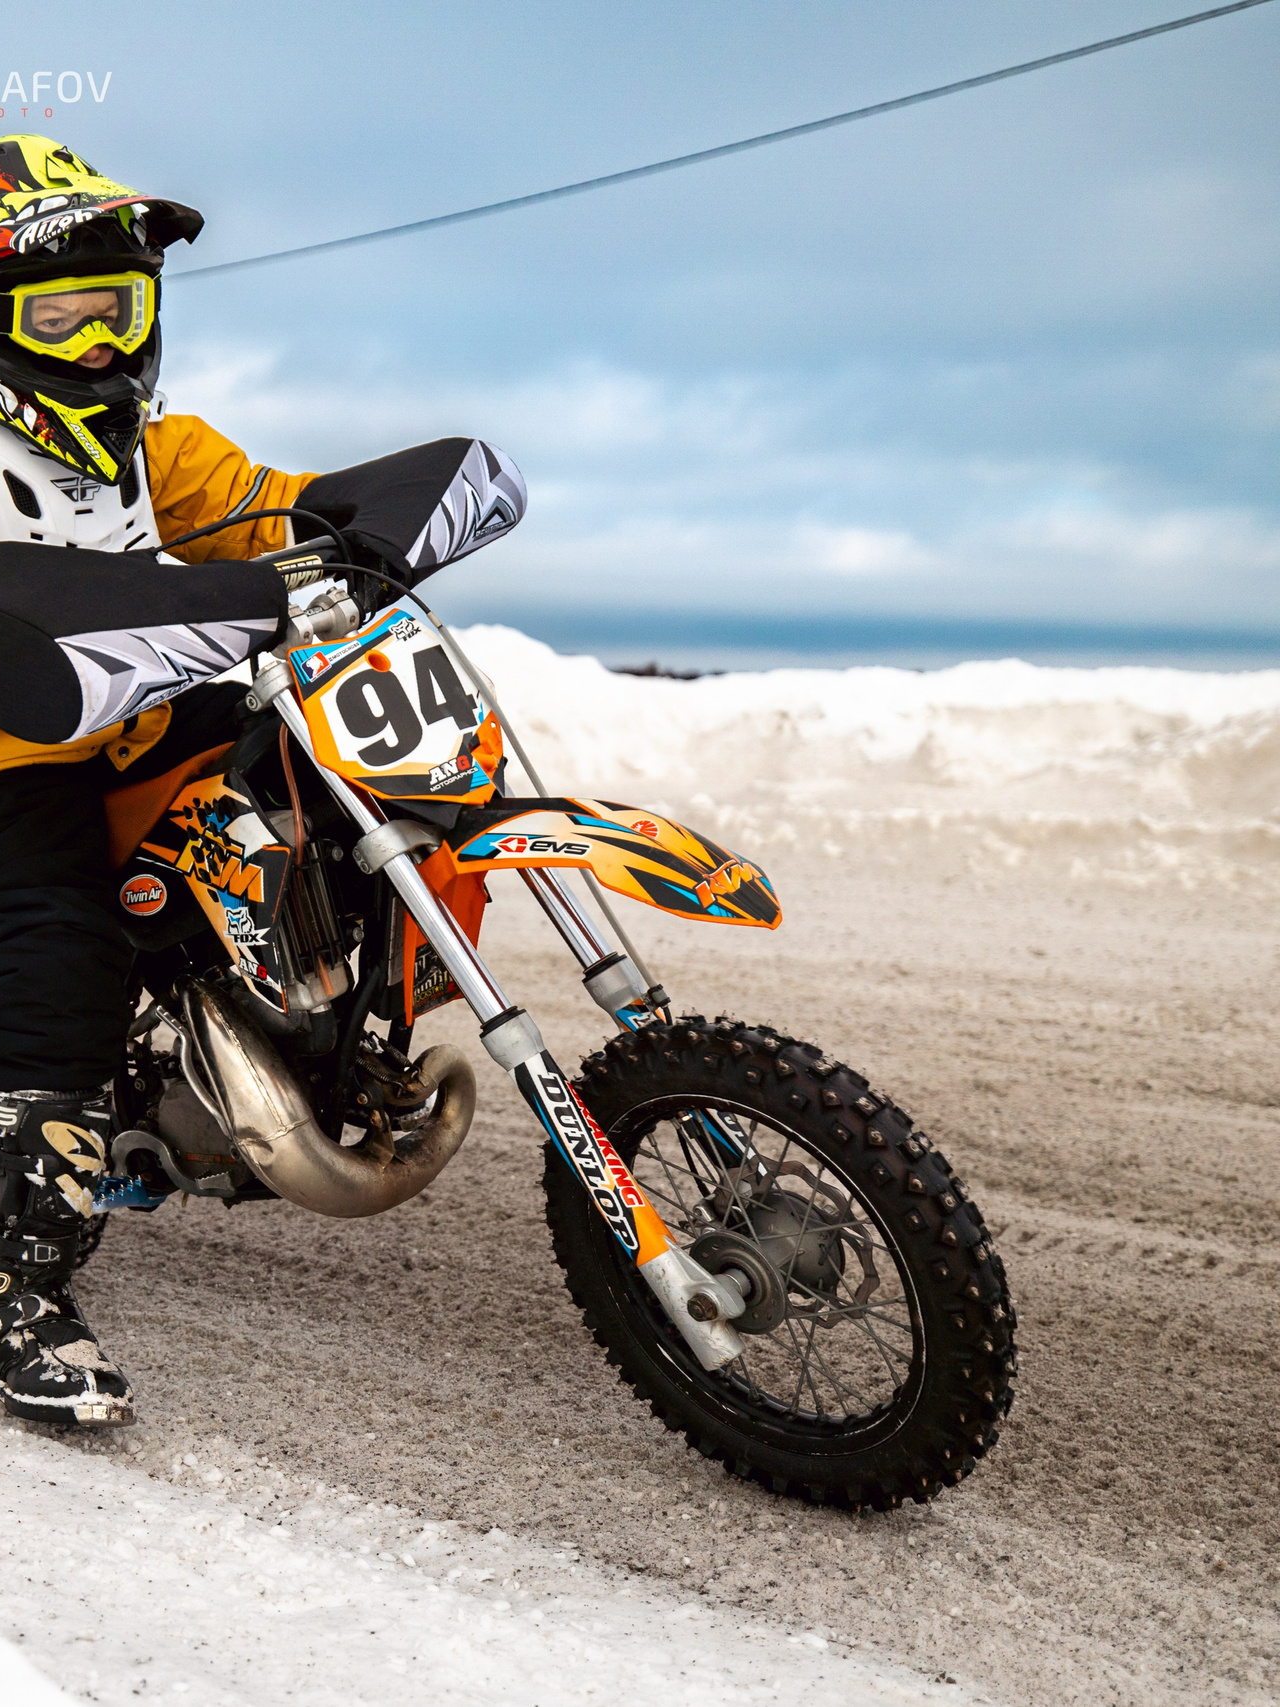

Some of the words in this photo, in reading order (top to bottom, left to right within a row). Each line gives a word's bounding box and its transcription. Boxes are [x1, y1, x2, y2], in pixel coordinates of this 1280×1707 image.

[335, 645, 478, 767] 94
[429, 755, 471, 786] ANG
[125, 889, 148, 904] Twin
[148, 886, 163, 901] Air
[233, 933, 261, 943] FOX
[239, 957, 267, 980] ANG
[538, 1072, 639, 1250] DUNLOP
